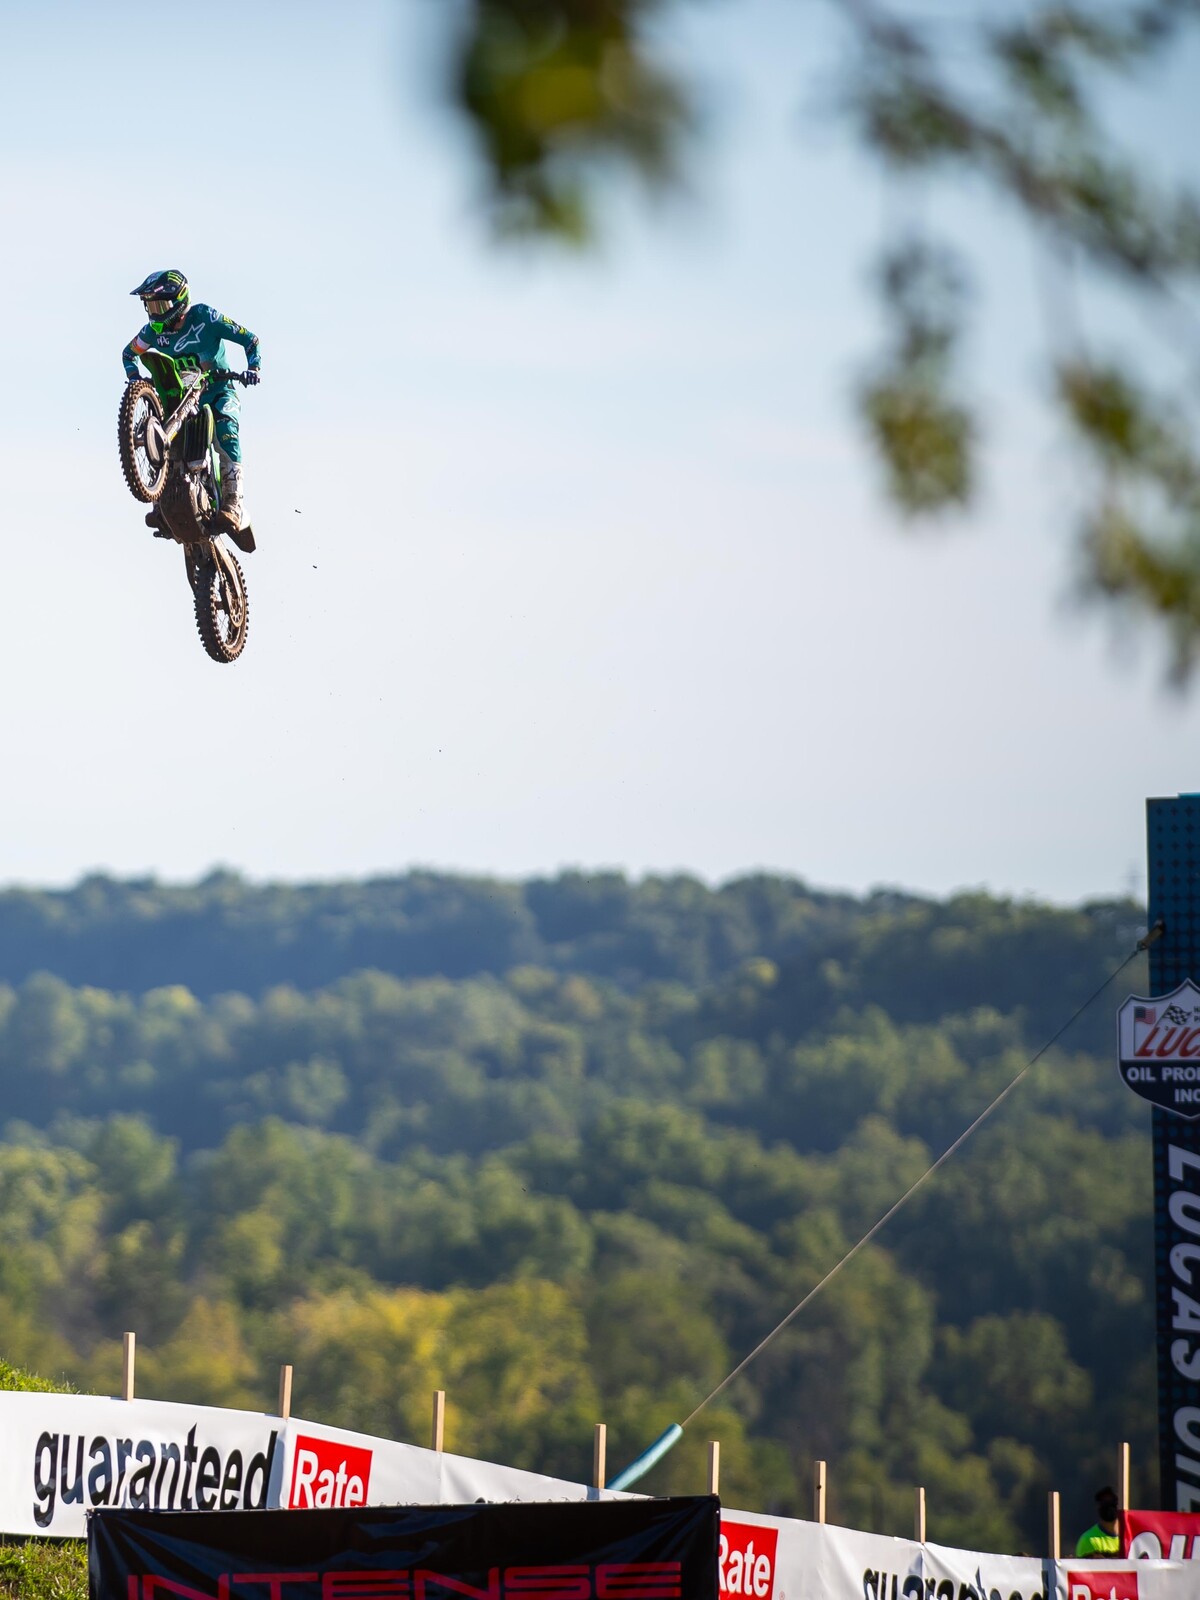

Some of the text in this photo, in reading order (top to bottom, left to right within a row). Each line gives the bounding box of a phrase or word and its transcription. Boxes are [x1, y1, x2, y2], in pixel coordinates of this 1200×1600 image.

[1135, 1027, 1200, 1057] LUC
[1126, 1066, 1200, 1082] OIL PRO
[33, 1423, 364, 1528] guaranteed Rate
[128, 1562, 682, 1600] INTENSE
